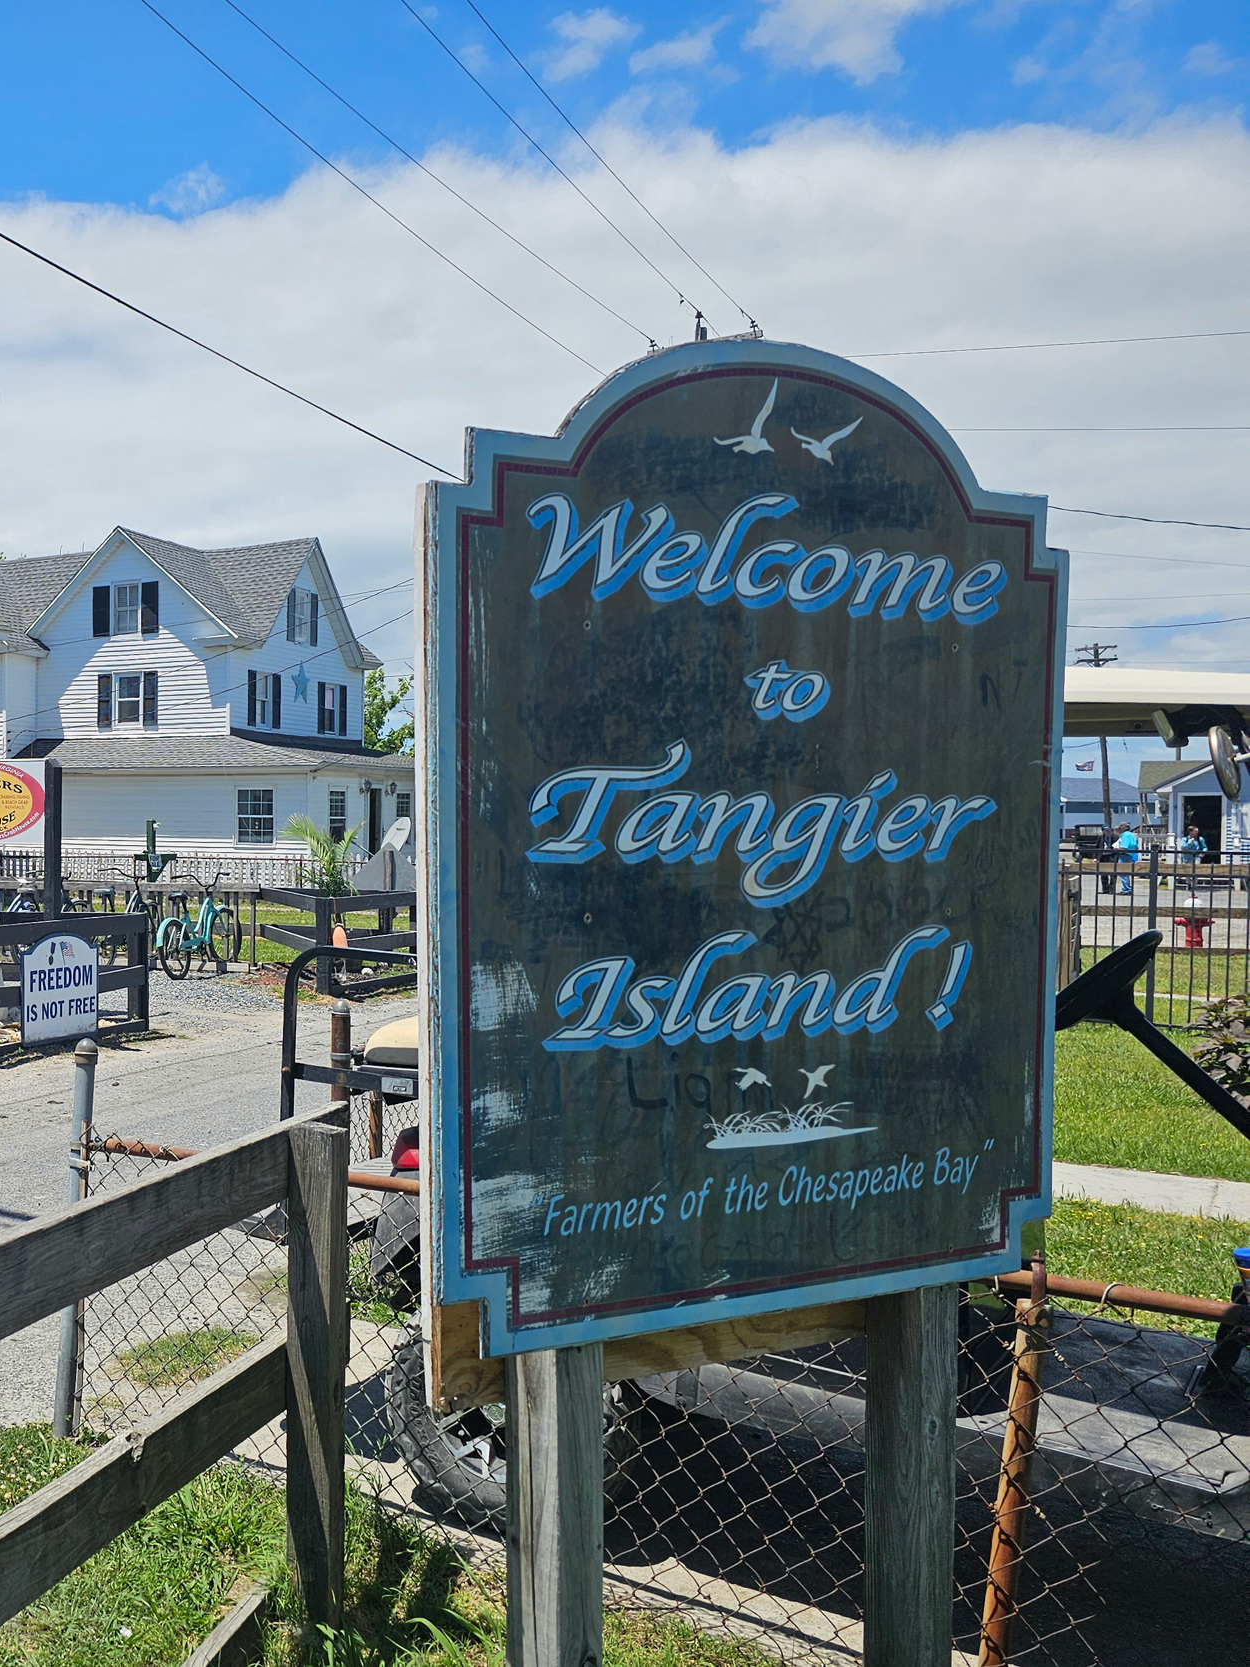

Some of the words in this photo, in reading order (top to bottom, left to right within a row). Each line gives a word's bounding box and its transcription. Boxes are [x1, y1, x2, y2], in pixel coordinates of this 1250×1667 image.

[525, 492, 1007, 626] Welcome
[744, 659, 831, 722] to
[524, 738, 998, 908] Tangier
[26, 1004, 38, 1022] IS
[42, 1000, 64, 1020] NOT
[69, 996, 96, 1016] FREE
[30, 964, 93, 992] FREEDOM
[541, 925, 950, 1051] Island
[680, 1175, 714, 1221] of
[725, 1171, 768, 1214] the
[778, 1152, 925, 1211] Chesapeake
[932, 1138, 995, 1195] Bay"
